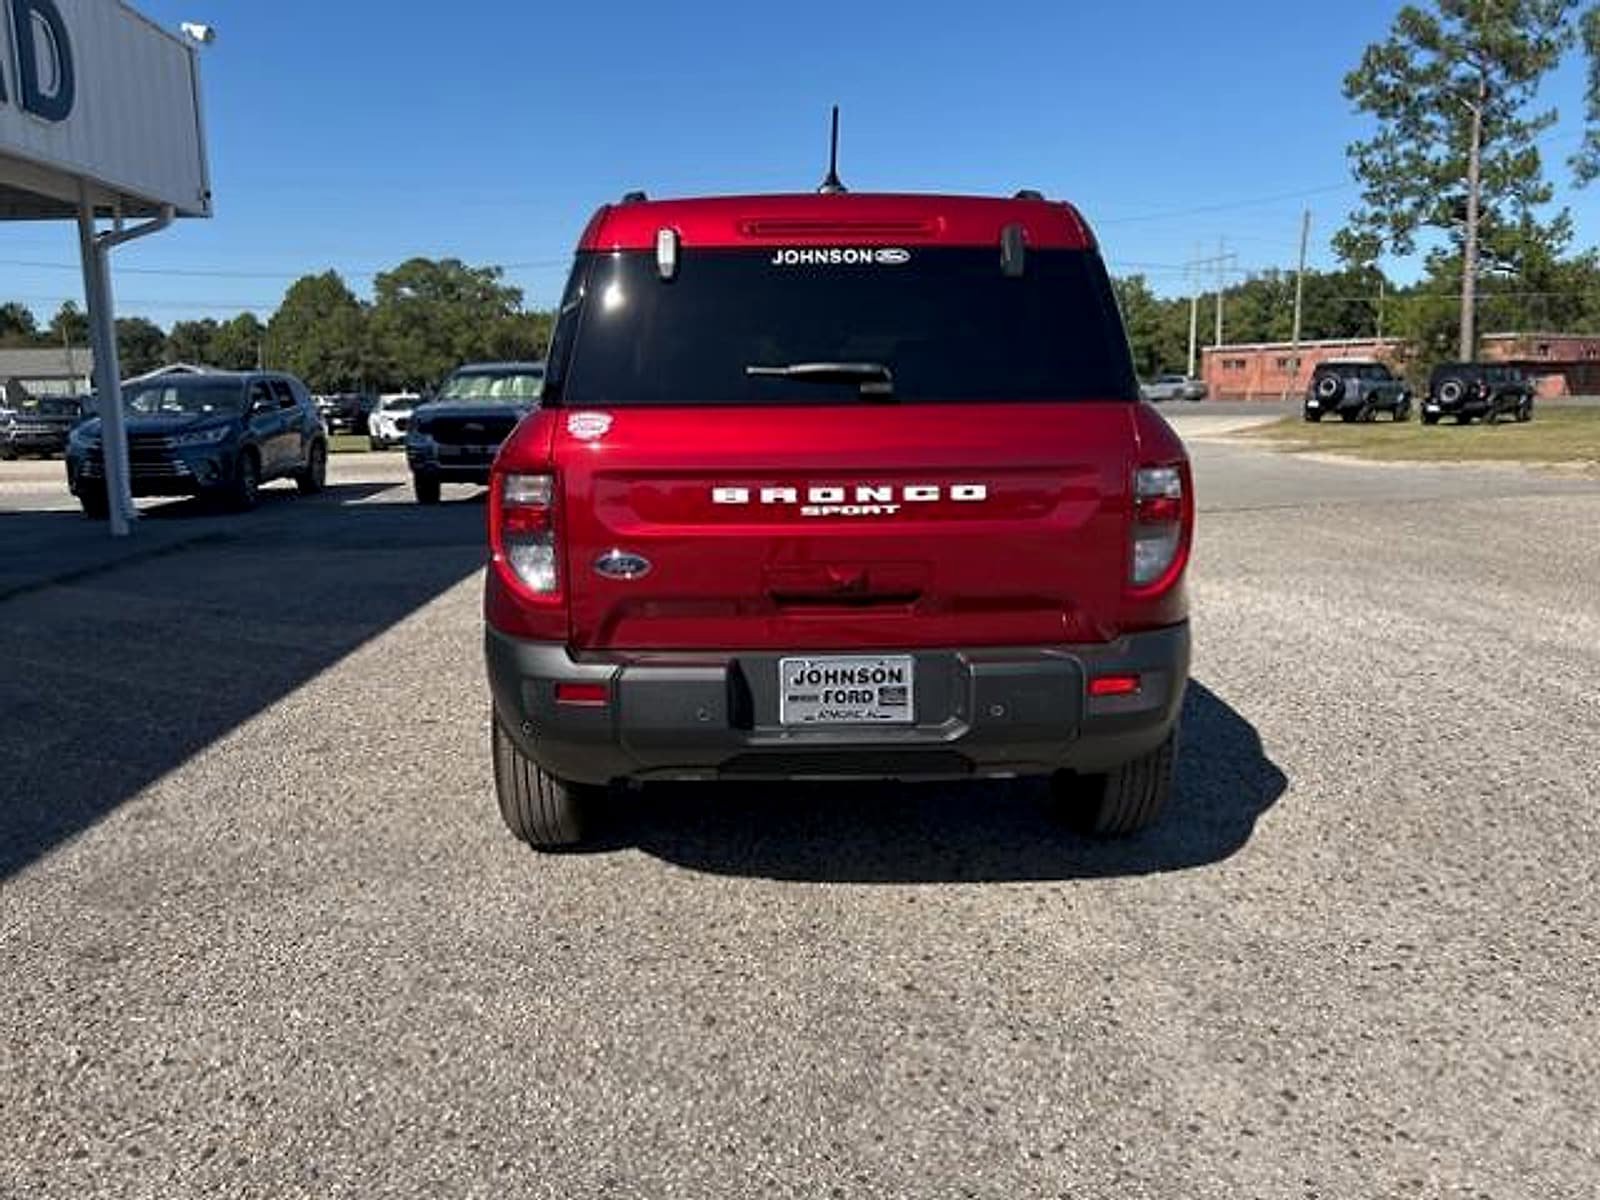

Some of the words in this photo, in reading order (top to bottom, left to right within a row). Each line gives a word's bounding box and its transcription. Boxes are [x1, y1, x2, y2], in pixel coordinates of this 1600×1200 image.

[772, 249, 872, 264] JOHNSON
[712, 485, 987, 503] BRONCO
[800, 504, 900, 516] SPORT
[794, 667, 902, 685] JOHNSON
[823, 690, 874, 703] FORD
